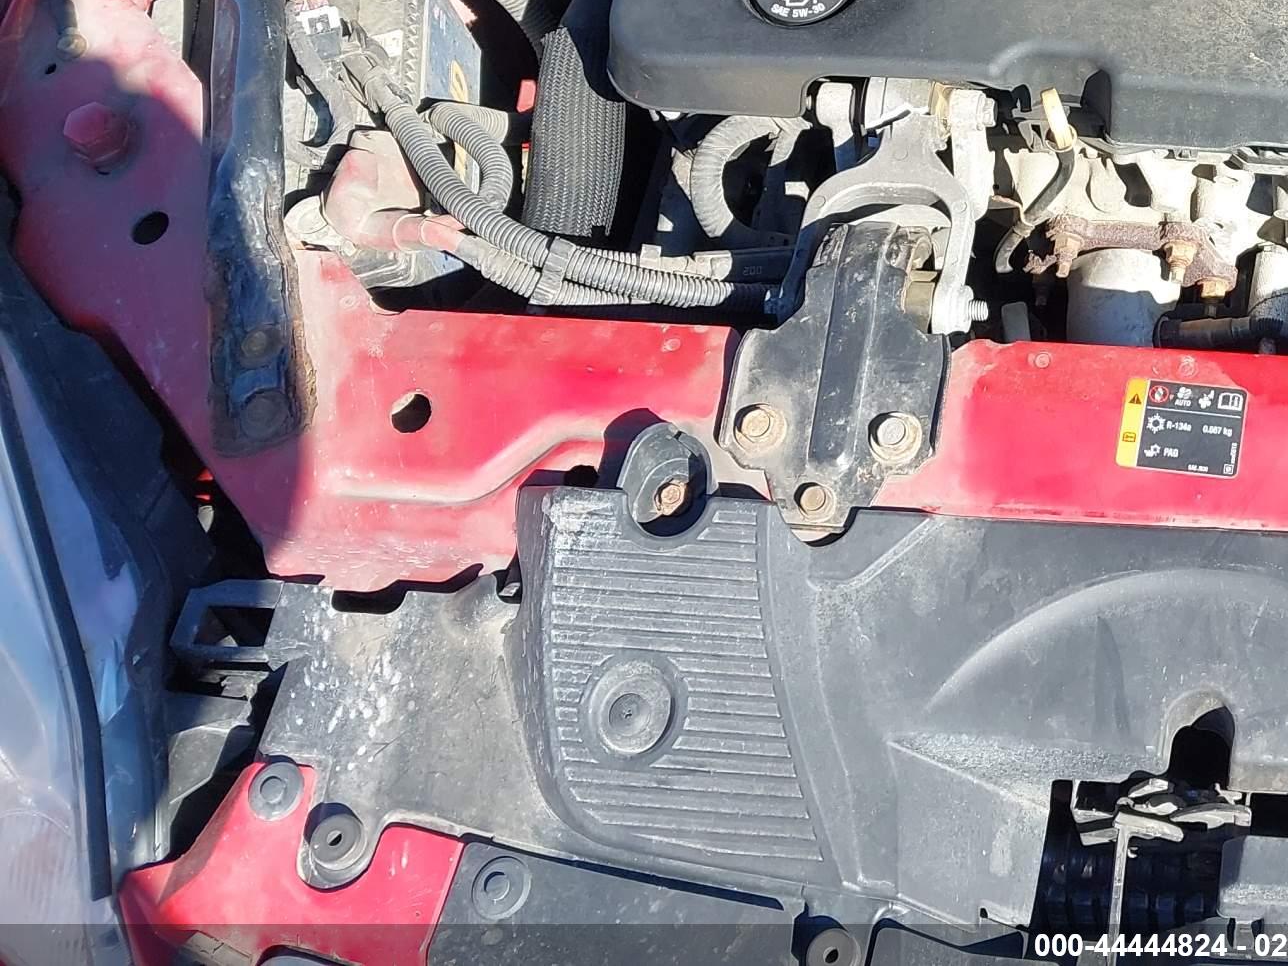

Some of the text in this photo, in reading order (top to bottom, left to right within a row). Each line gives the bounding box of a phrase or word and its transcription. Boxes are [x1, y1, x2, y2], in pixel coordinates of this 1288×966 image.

[770, 3, 826, 18] SAE 5W-30
[1174, 399, 1192, 407] AUTO
[1166, 422, 1192, 432] R-134a
[1223, 427, 1233, 438] kg
